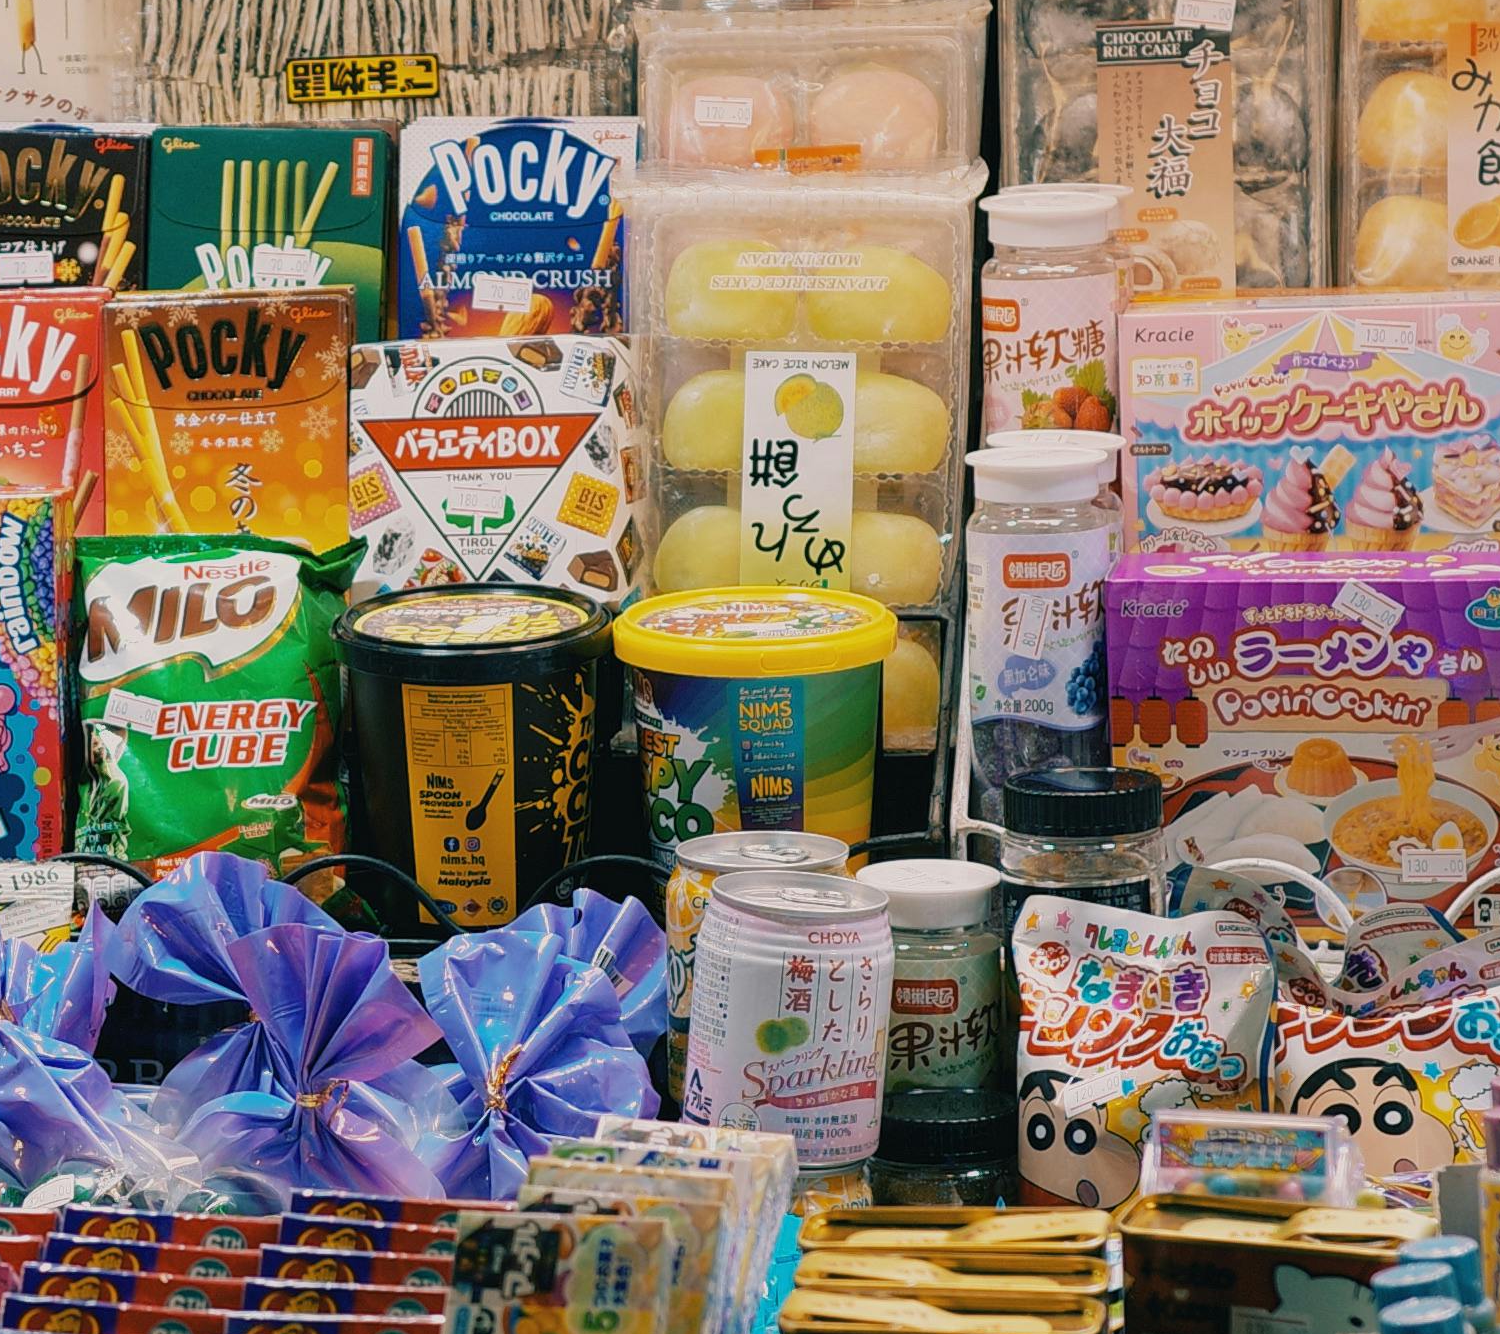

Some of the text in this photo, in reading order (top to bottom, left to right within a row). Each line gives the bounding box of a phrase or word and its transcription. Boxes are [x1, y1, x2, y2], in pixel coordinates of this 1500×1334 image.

[1102, 30, 1194, 45] CHOCOLATE
[1102, 42, 1181, 58] RICE CAKE
[94, 138, 135, 155] Glico
[161, 136, 201, 152] Glico
[1147, 114, 1194, 199] 大福
[352, 142, 372, 193] 期間限定
[430, 128, 608, 216] Pocky
[490, 210, 555, 223] CHOCOLATE
[1451, 255, 1494, 266] ORANGE
[533, 269, 612, 290] CRUSH
[53, 308, 94, 323] Glico
[289, 306, 332, 321] Glico
[1134, 327, 1195, 344] Kracie
[139, 308, 307, 392] Pocky
[1136, 373, 1195, 388] 知育菓子
[1190, 377, 1478, 437] ホイップケーキやさん
[173, 410, 278, 428] 黄金バター仕立て
[395, 425, 561, 461] バラエティBOX
[446, 472, 512, 482] THANK YOU
[351, 477, 381, 502] BIS
[578, 486, 607, 512] BIS
[458, 537, 497, 547] TIROL
[526, 519, 562, 548] WHITE
[461, 548, 494, 556] CHOCO
[1120, 599, 1183, 619] Kracie
[87, 576, 281, 662] MILO
[739, 701, 792, 718] NIMS
[993, 698, 1054, 716] 净含量 200g
[153, 698, 317, 740] ENERGY
[739, 719, 794, 735] SQUAD
[167, 732, 291, 772] CUBE
[1222, 748, 1287, 759] マンゴープリン
[426, 773, 454, 790] NIMS
[751, 773, 793, 799] NIMS
[419, 790, 462, 800] SPOON
[419, 800, 464, 808] PROVIDED
[440, 853, 485, 867] nims.hq
[10, 867, 60, 890] 1986
[437, 876, 492, 888] Malaysia
[808, 931, 862, 945] CHOYA
[785, 954, 817, 1014] 梅酒
[822, 958, 843, 1044] とした
[856, 956, 873, 1042] さらり
[742, 1049, 880, 1100] Sparkling
